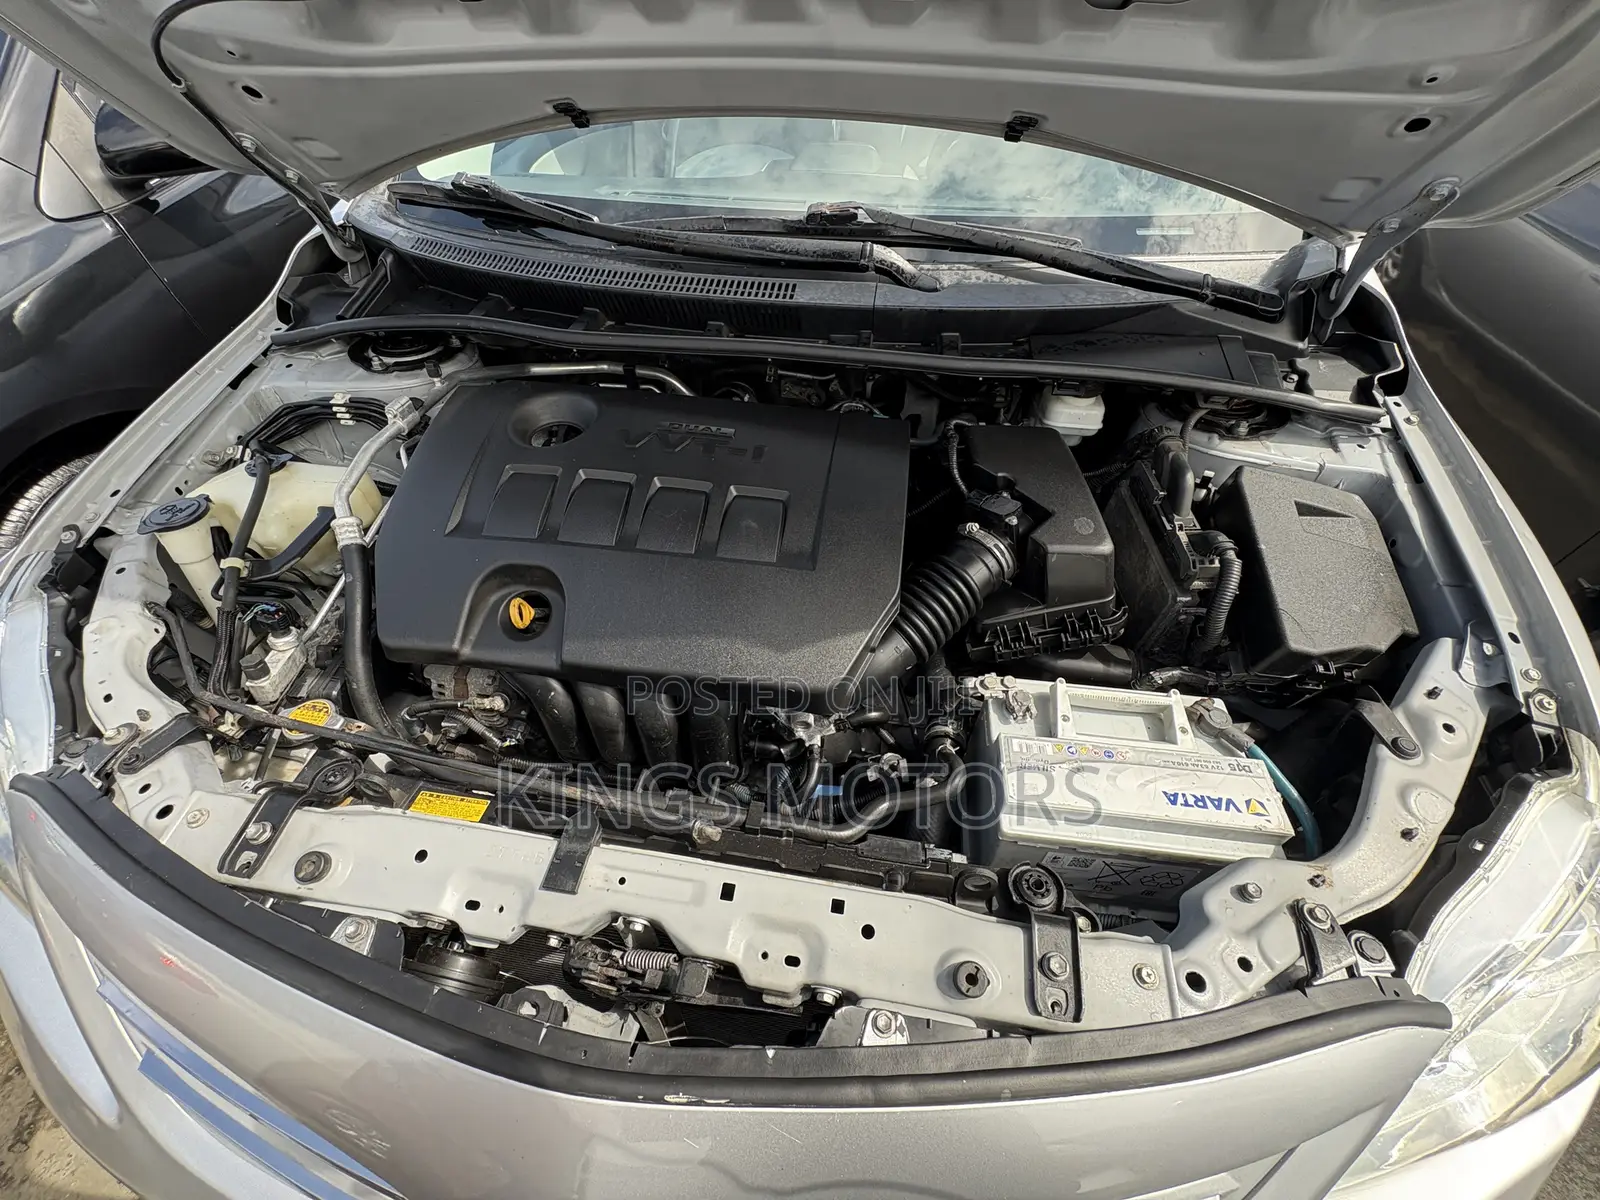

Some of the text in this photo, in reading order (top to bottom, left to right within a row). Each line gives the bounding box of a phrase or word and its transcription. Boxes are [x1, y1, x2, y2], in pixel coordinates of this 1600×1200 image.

[667, 422, 729, 436] DUAL
[1161, 790, 1243, 814] VARTA
[1092, 884, 1113, 892] Pb
